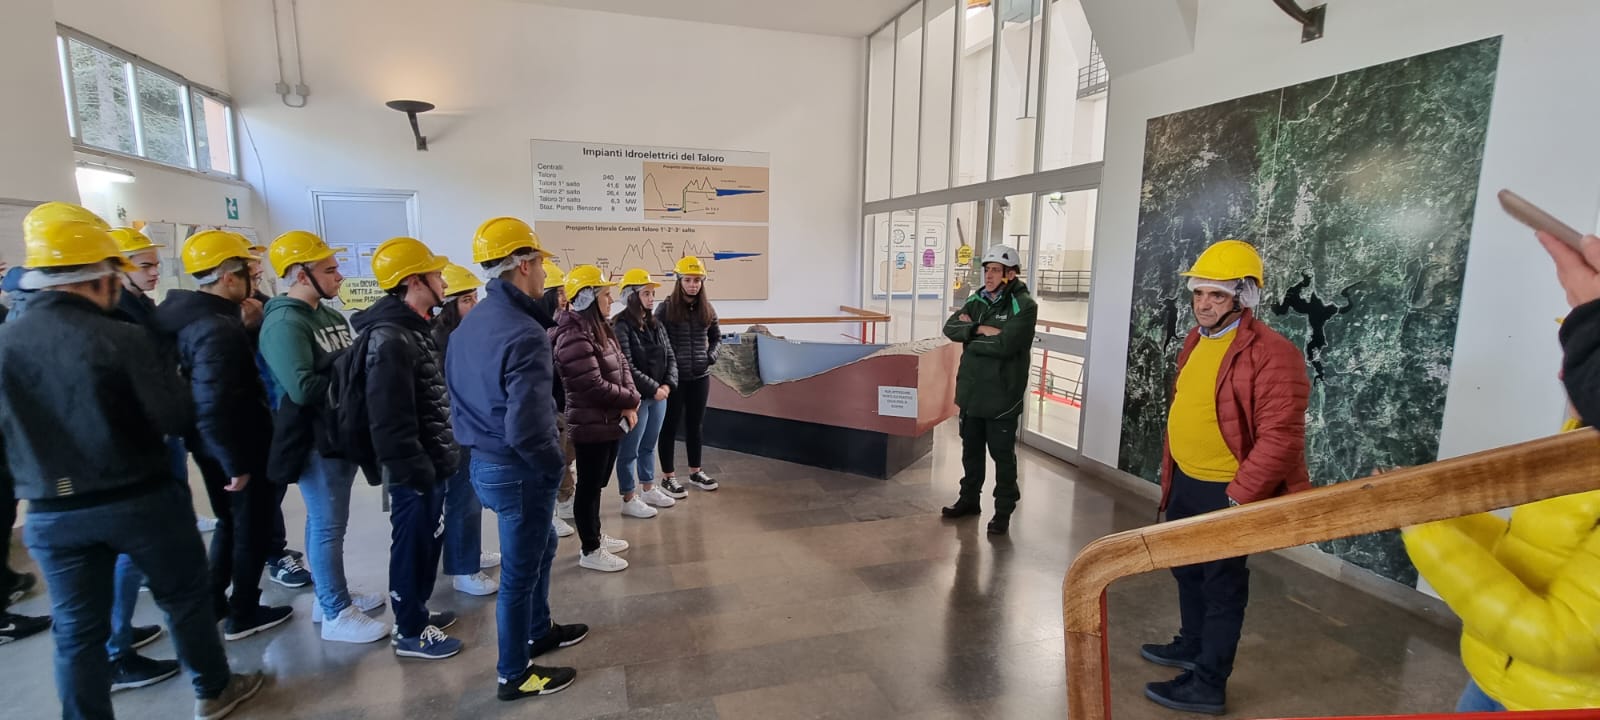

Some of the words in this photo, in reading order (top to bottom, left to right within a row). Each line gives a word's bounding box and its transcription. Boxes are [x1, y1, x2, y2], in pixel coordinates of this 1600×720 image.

[583, 147, 622, 158] Impianti
[625, 149, 678, 160] Idroelettrici
[681, 152, 694, 161] del
[697, 153, 725, 162] Taloro
